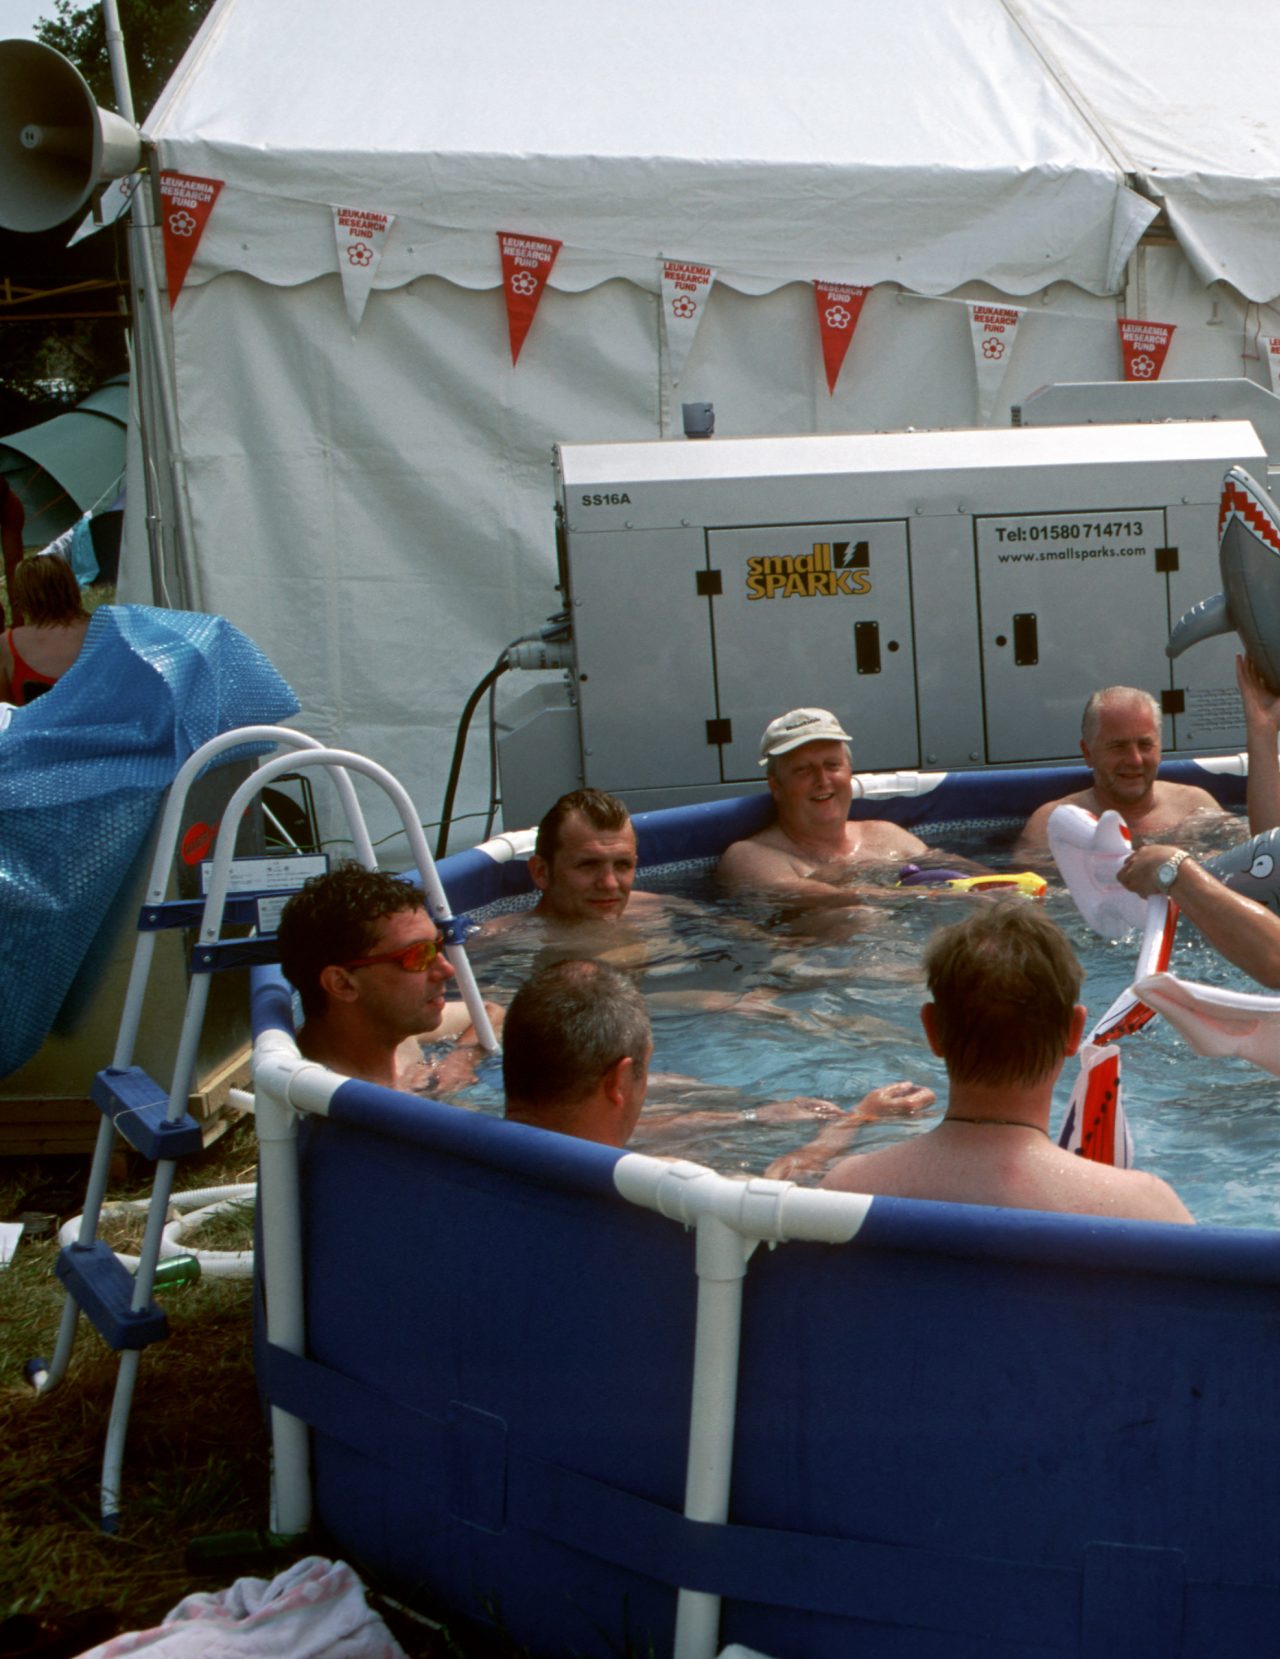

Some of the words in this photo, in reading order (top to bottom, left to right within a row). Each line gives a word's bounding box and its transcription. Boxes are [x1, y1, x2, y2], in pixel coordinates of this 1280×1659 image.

[161, 176, 214, 194] LEUKAEMIA
[161, 185, 211, 202] RESEARCH
[172, 196, 198, 209] FUND
[337, 208, 388, 223] LEUKAEMIA
[339, 217, 385, 232] RESEARCH
[349, 228, 373, 239] FUND
[503, 236, 553, 252] LEUKAEMIA
[503, 246, 551, 262] RESEARCH
[514, 256, 539, 269] FUND
[663, 261, 711, 276] LEUKAEMIA
[664, 270, 709, 285] RESEARCH
[674, 281, 697, 292] FUND
[827, 292, 851, 303] FUND
[973, 304, 1018, 318] LEUKAEMIA
[974, 314, 1016, 327] RESEARCH
[983, 324, 1005, 334] FUND
[1122, 323, 1168, 336] LEUKAEMIA
[1123, 332, 1167, 345] RESEARCH
[1133, 342, 1156, 352] FUND
[581, 493, 632, 506] SS16A
[1083, 521, 1144, 538] 714713
[746, 542, 832, 576] small
[998, 546, 1147, 563] www.smallsparks.com
[746, 569, 873, 601] SPARKS
